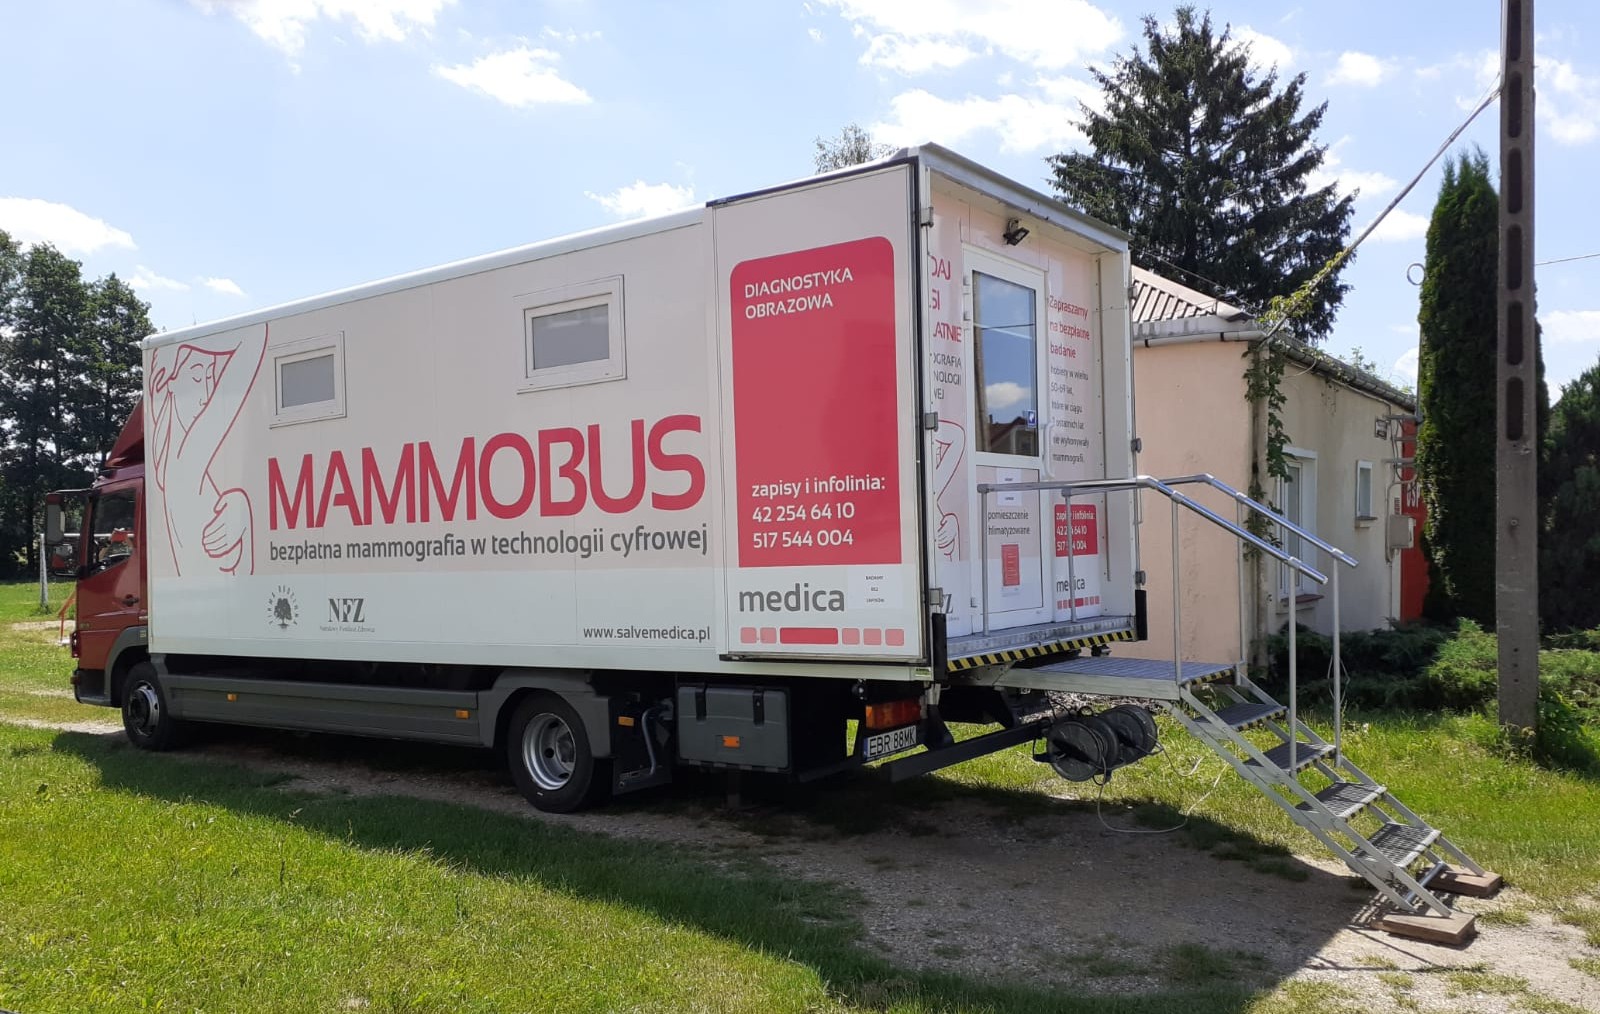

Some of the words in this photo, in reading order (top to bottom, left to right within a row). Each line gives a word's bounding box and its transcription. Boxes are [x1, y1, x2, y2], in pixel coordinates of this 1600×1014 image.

[745, 267, 854, 298] DIAGNOSTYKA
[745, 293, 833, 319] OBRAZOWA
[1049, 295, 1088, 320] Zapraszamy
[933, 321, 962, 343] ATNIE
[1050, 321, 1058, 332] na
[1050, 341, 1076, 358] badanie
[268, 414, 706, 530] MAMMOBUS
[752, 479, 802, 499] zapisy
[805, 477, 810, 494] i
[814, 474, 886, 494] infolinia:
[752, 506, 772, 523] 42
[776, 505, 807, 522] 254
[810, 503, 832, 520] 64
[836, 502, 855, 519] 10
[270, 540, 342, 565] bezpłatna
[346, 533, 466, 562] mammografia
[471, 537, 487, 556] w
[491, 528, 604, 559] technologii
[610, 523, 708, 559] cyfrowej
[753, 531, 778, 548] 517
[782, 530, 813, 547] 544
[817, 529, 854, 546] 004
[1056, 575, 1086, 592] meica
[739, 582, 845, 613] medica
[328, 598, 365, 622] NFZ
[583, 625, 711, 643] www.salvemedica.pl
[869, 734, 891, 756] EBR
[893, 727, 916, 750] 88MK
